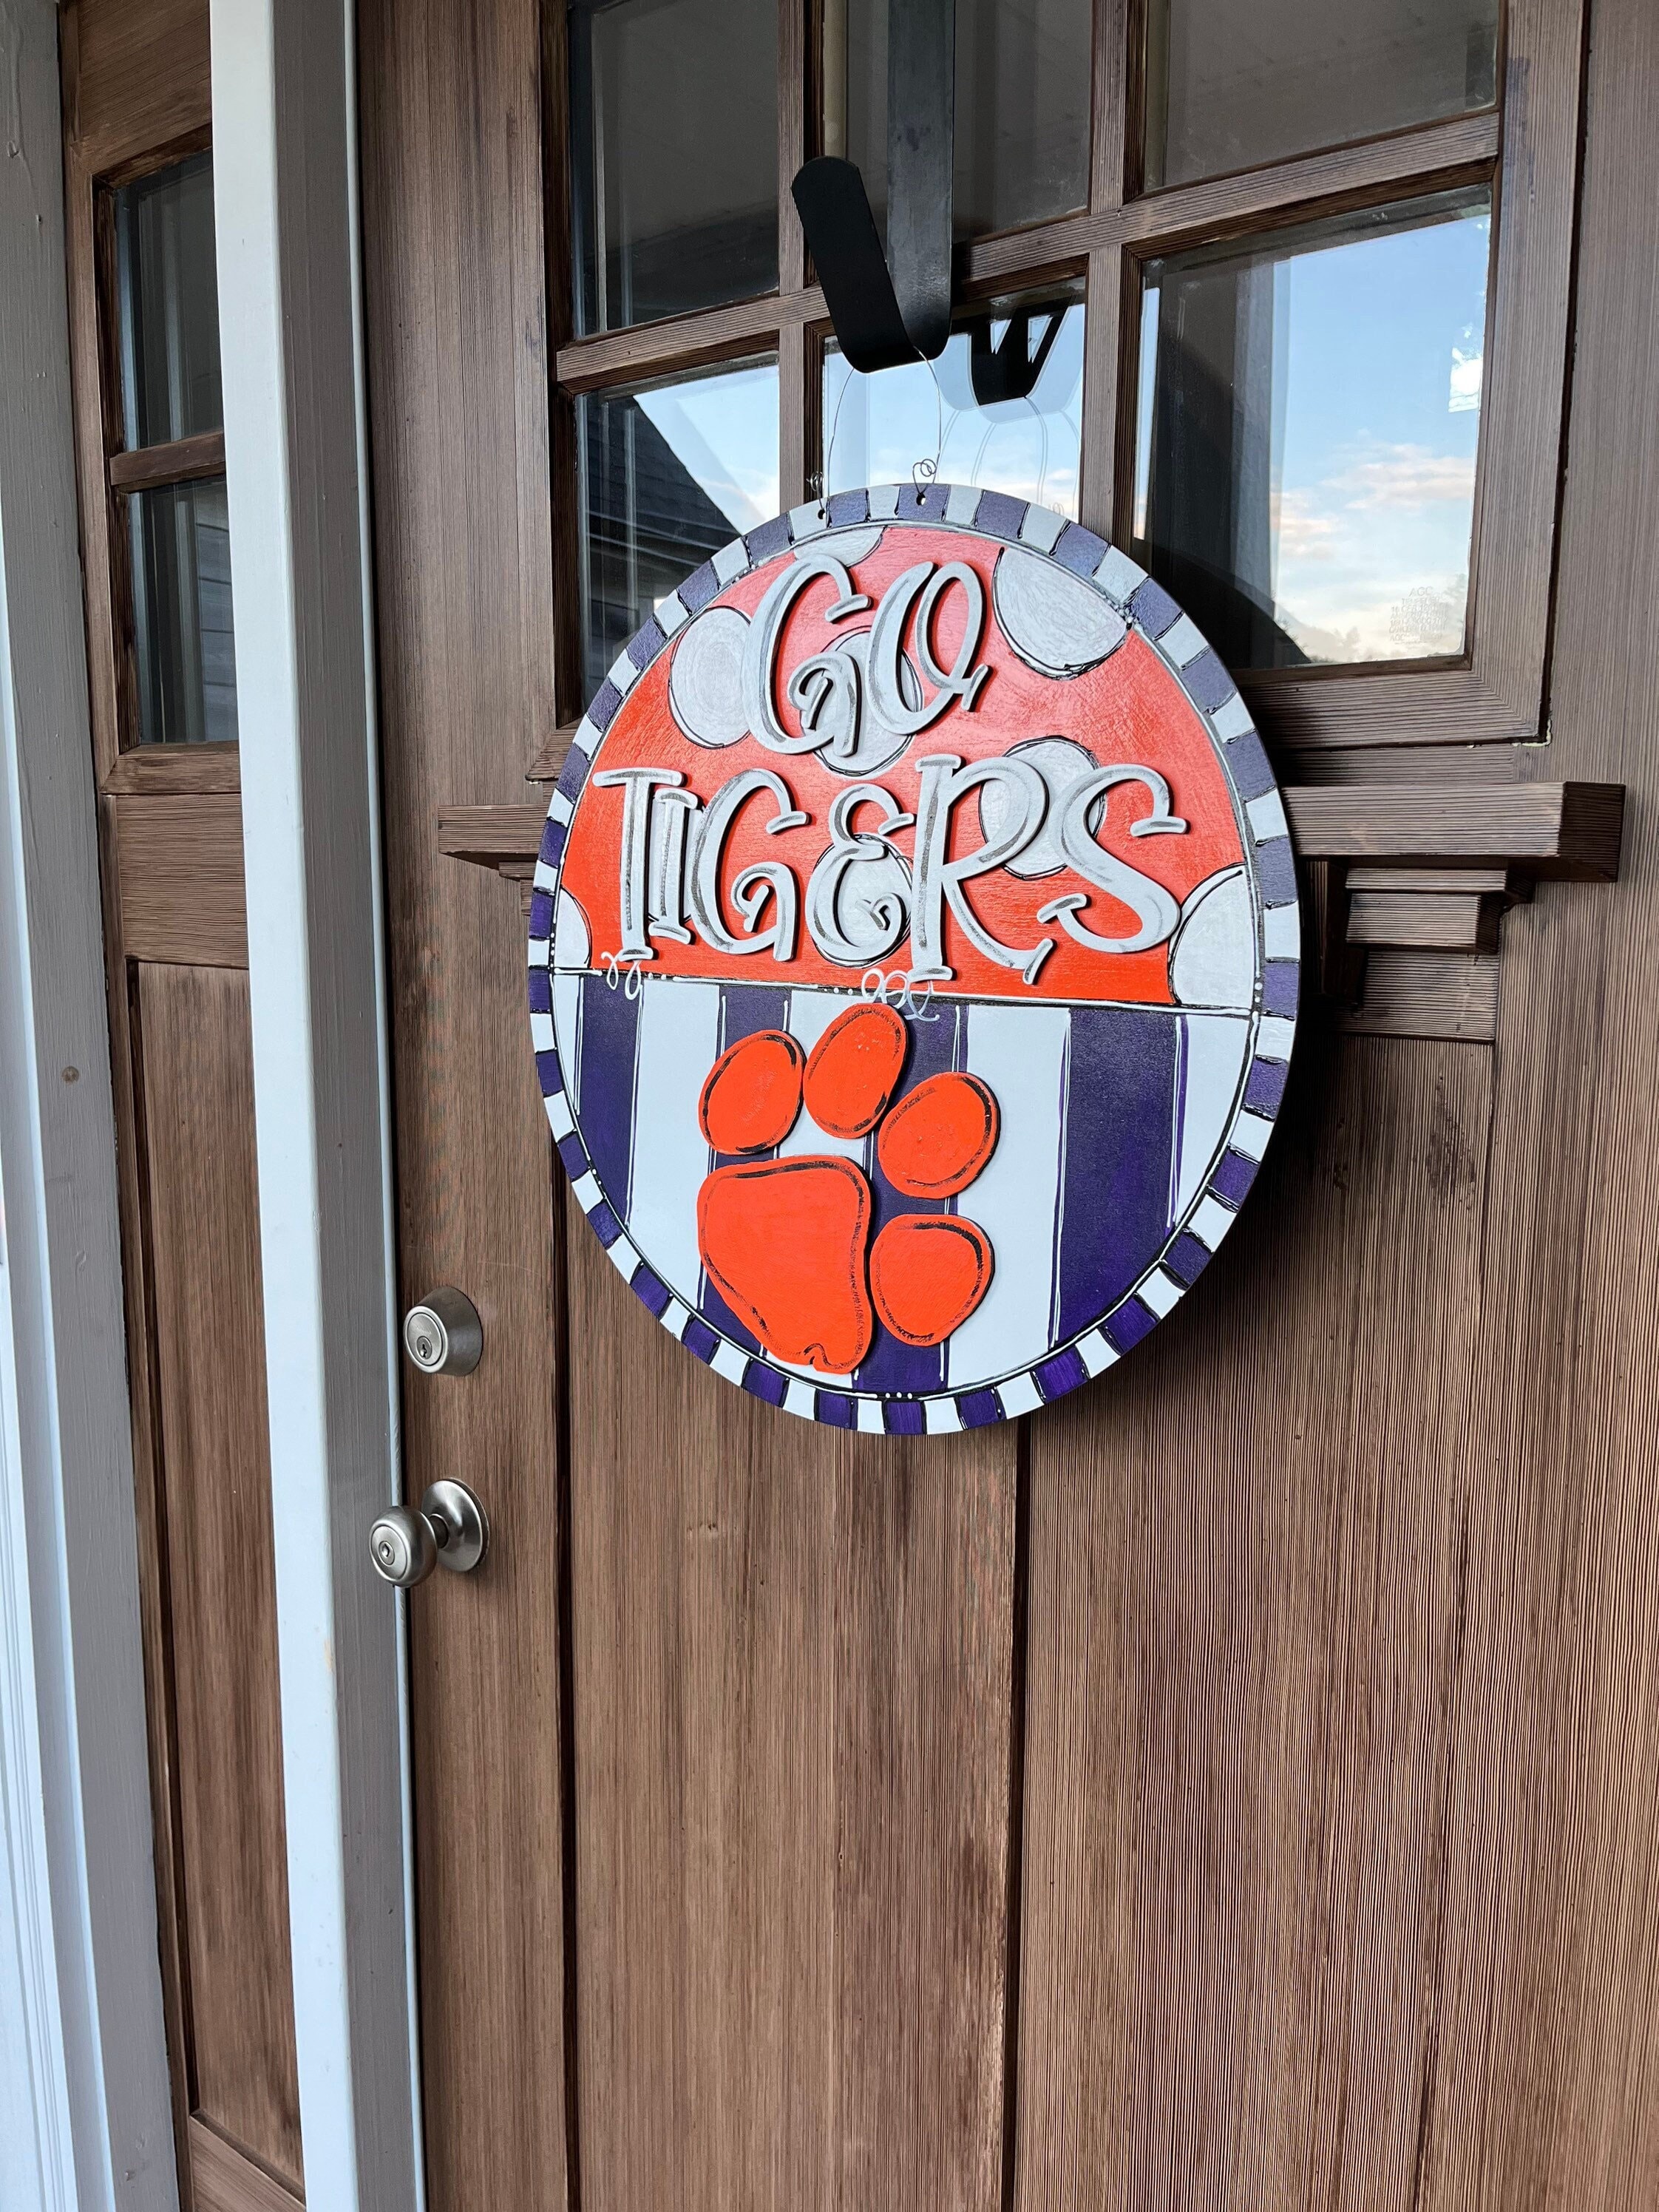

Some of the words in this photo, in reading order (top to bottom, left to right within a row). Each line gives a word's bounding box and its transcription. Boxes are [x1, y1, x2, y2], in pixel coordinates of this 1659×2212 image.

[742, 554, 989, 757] GO
[1408, 586, 1434, 597] AGC
[593, 754, 1188, 985] TIGERS
